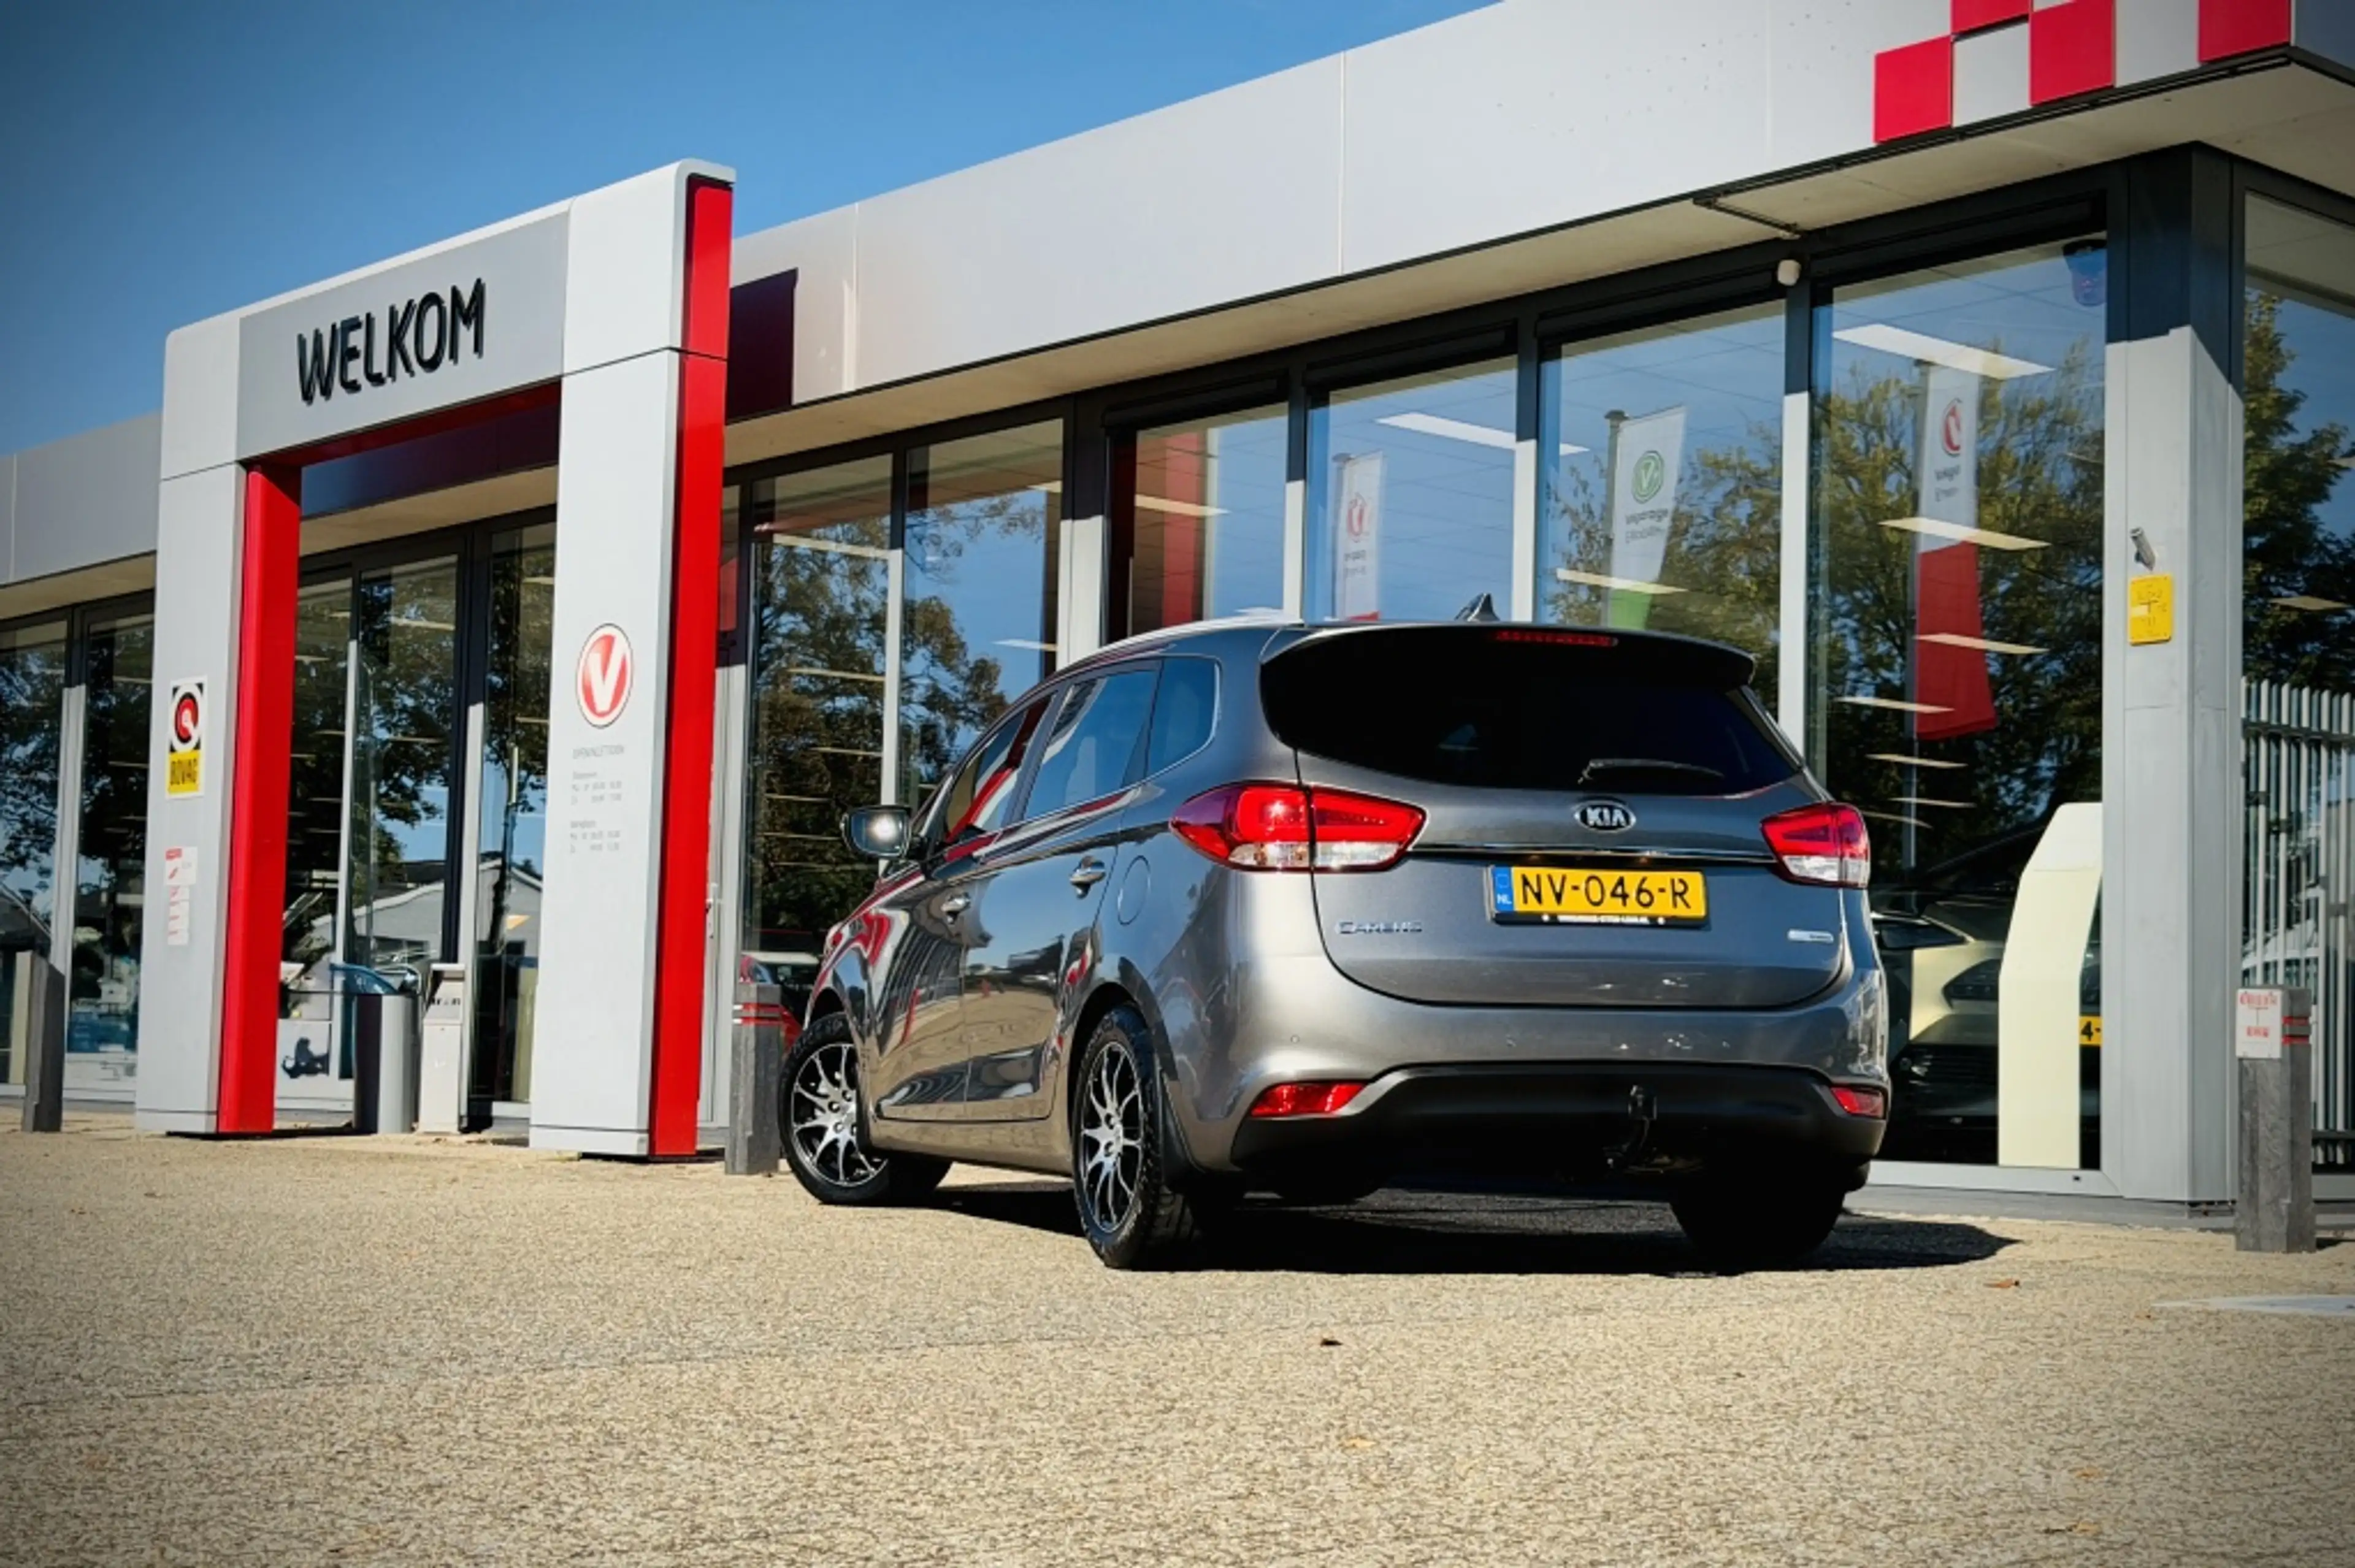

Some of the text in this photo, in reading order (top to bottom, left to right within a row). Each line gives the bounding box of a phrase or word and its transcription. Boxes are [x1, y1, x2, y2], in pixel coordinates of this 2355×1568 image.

[297, 277, 486, 407] WELKOM
[1587, 806, 1626, 827] KIA
[1496, 893, 1512, 905] NL
[1521, 873, 1691, 909] NV-046-R
